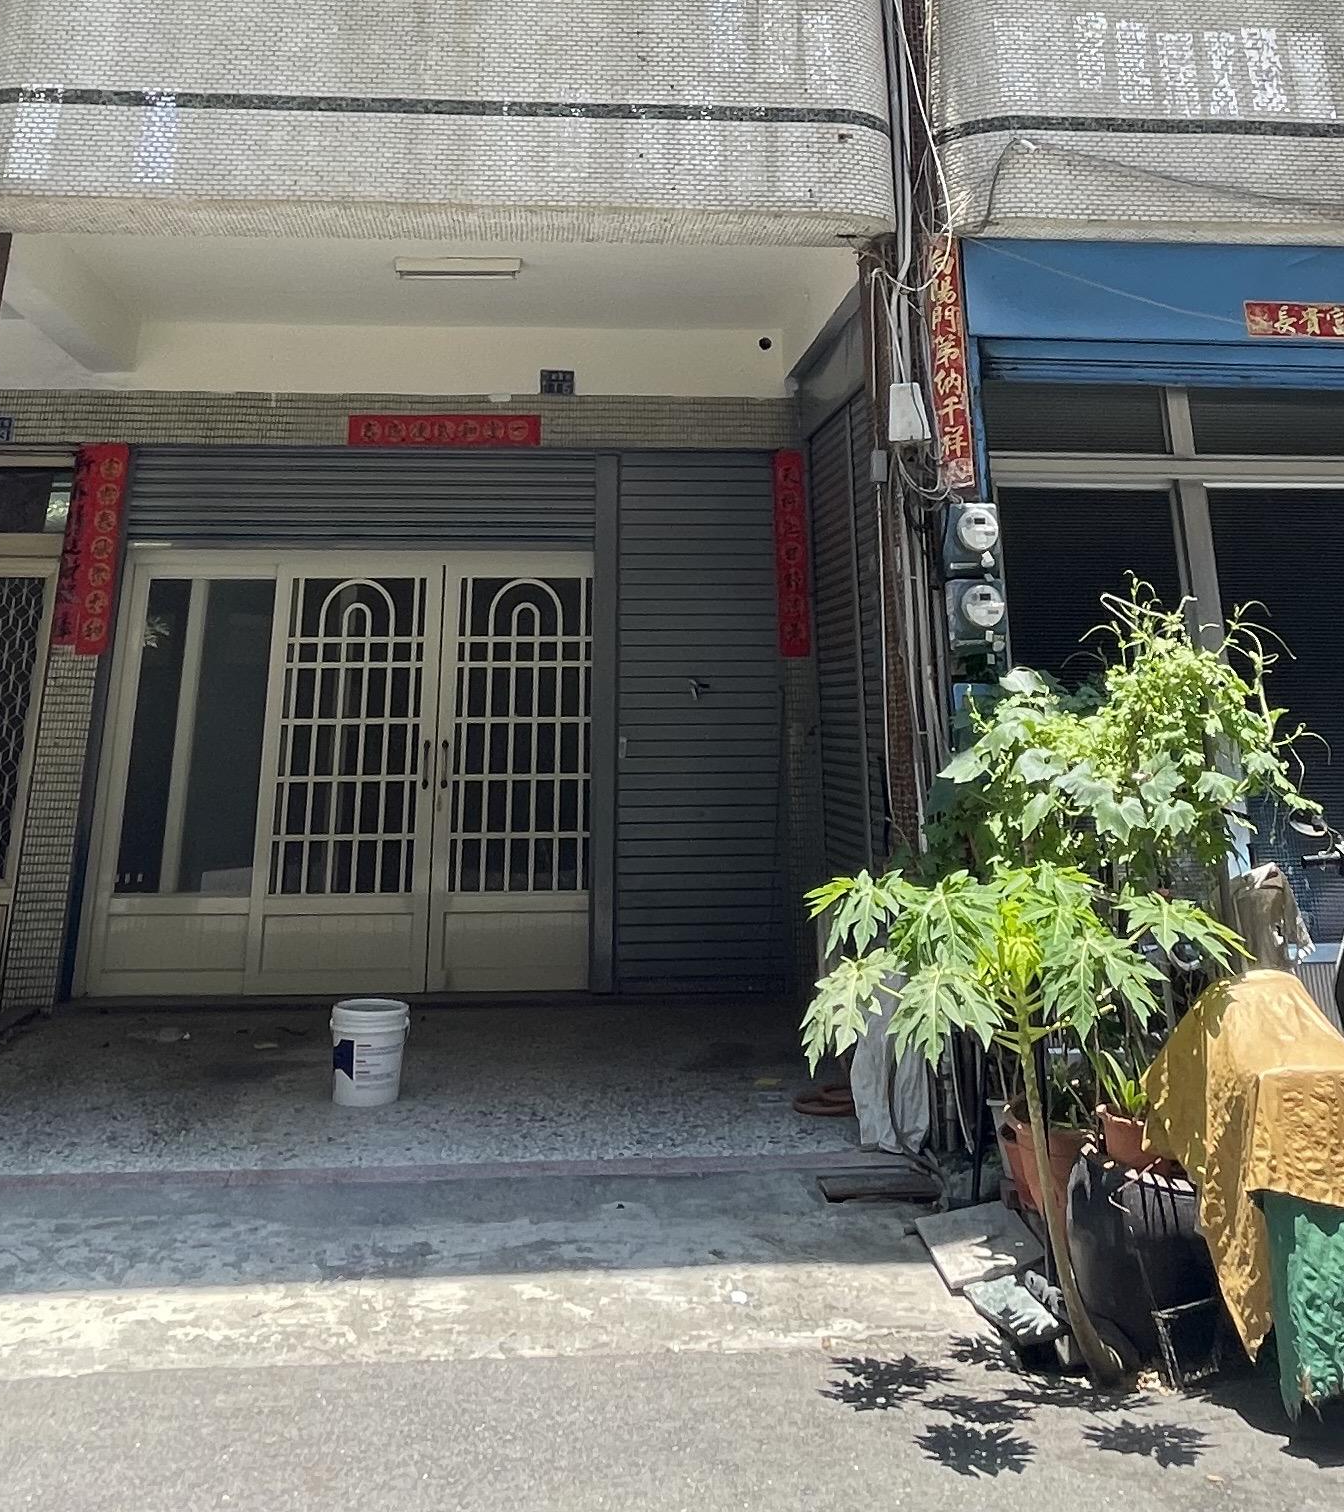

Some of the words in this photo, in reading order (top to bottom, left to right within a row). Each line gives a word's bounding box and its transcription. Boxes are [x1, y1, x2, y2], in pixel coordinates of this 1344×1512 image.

[929, 245, 968, 458] 向陽門第納千祥
